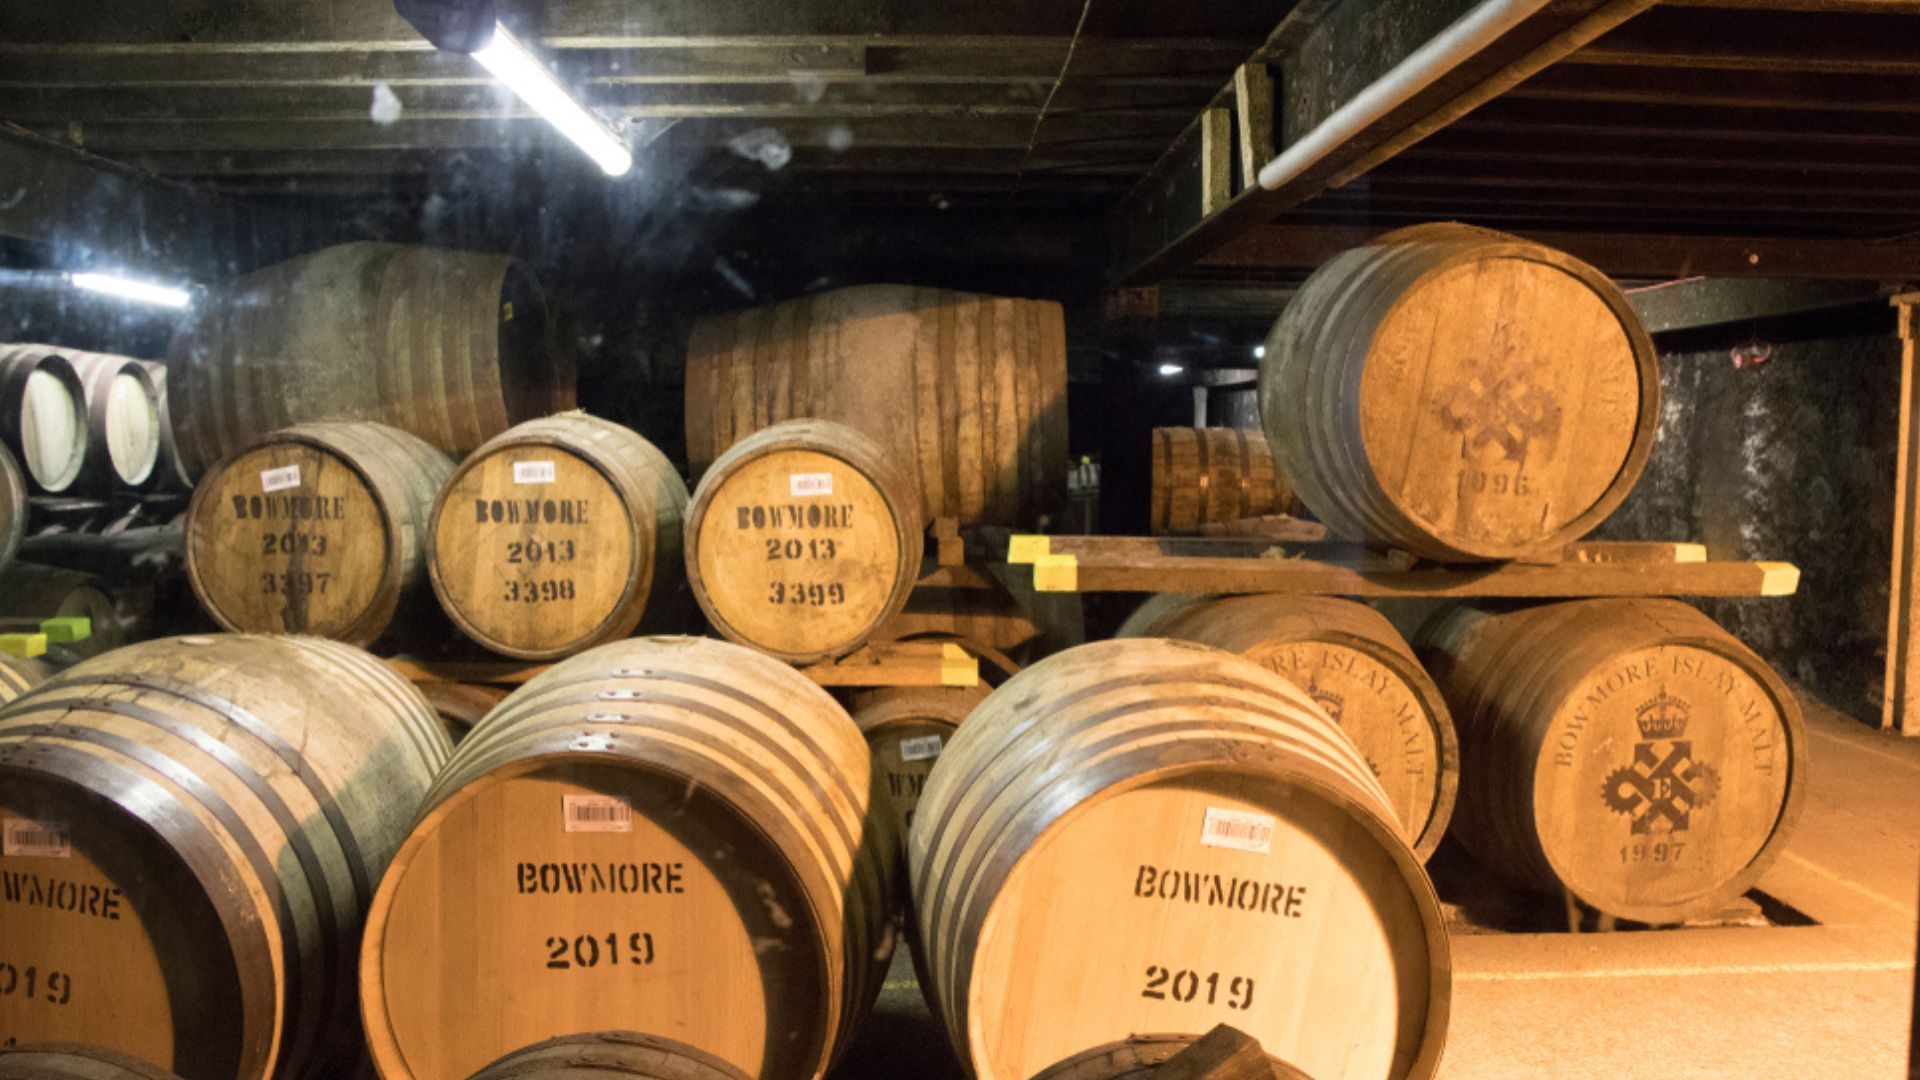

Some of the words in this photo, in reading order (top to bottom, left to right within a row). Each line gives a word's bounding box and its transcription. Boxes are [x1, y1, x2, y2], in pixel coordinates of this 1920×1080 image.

[231, 495, 346, 521] BOWMORE
[474, 499, 589, 525] BOWMORE
[736, 504, 854, 531] BOWMORE
[261, 532, 328, 556] 2013
[507, 537, 576, 564] 2013
[765, 538, 837, 560] 2013
[261, 572, 331, 595] 3397
[503, 579, 576, 604] 3398
[769, 581, 845, 607] 3399
[1321, 651, 1394, 695] ISLAY
[1395, 701, 1425, 784] MALT
[1554, 656, 1659, 768] BOWMORE
[1672, 655, 1742, 696] ISLAY
[1741, 699, 1774, 776] MALT
[1619, 842, 1688, 864] 1997
[516, 862, 685, 894] BOWMORE
[1134, 864, 1307, 918] BOWMORE
[546, 932, 654, 969] 2019
[1141, 965, 1255, 1010] 2019
